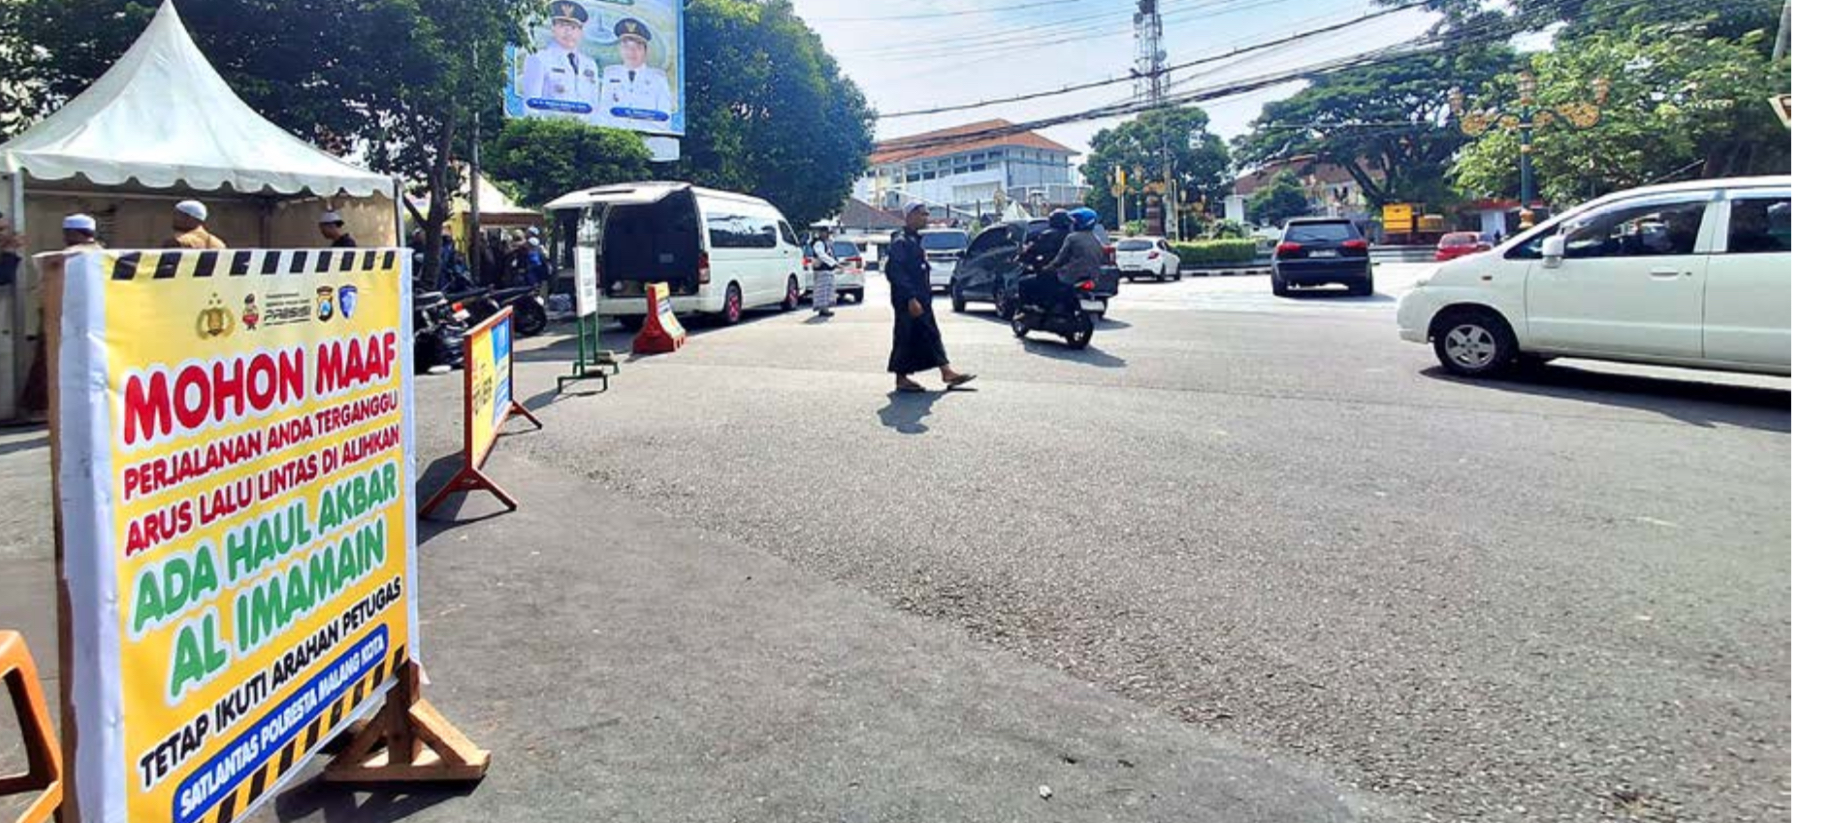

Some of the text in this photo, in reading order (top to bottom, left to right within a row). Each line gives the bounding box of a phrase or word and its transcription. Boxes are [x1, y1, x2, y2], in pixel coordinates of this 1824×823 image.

[124, 347, 304, 446] MOHON
[316, 332, 396, 395] MAAF
[124, 390, 398, 500] PERJALANAN ANDA TERGANGGU
[126, 425, 400, 556] ARUS LALU LINTAS DI ALIHKAN
[134, 462, 397, 632] ADA HAUL AKBAR
[140, 576, 402, 787] TETAP IKUTI ARAHAN PETUGAS
[170, 519, 384, 697] AL IMAMAIN
[180, 634, 386, 818] SATLANTAS POLRESTA MALANG KOTA
